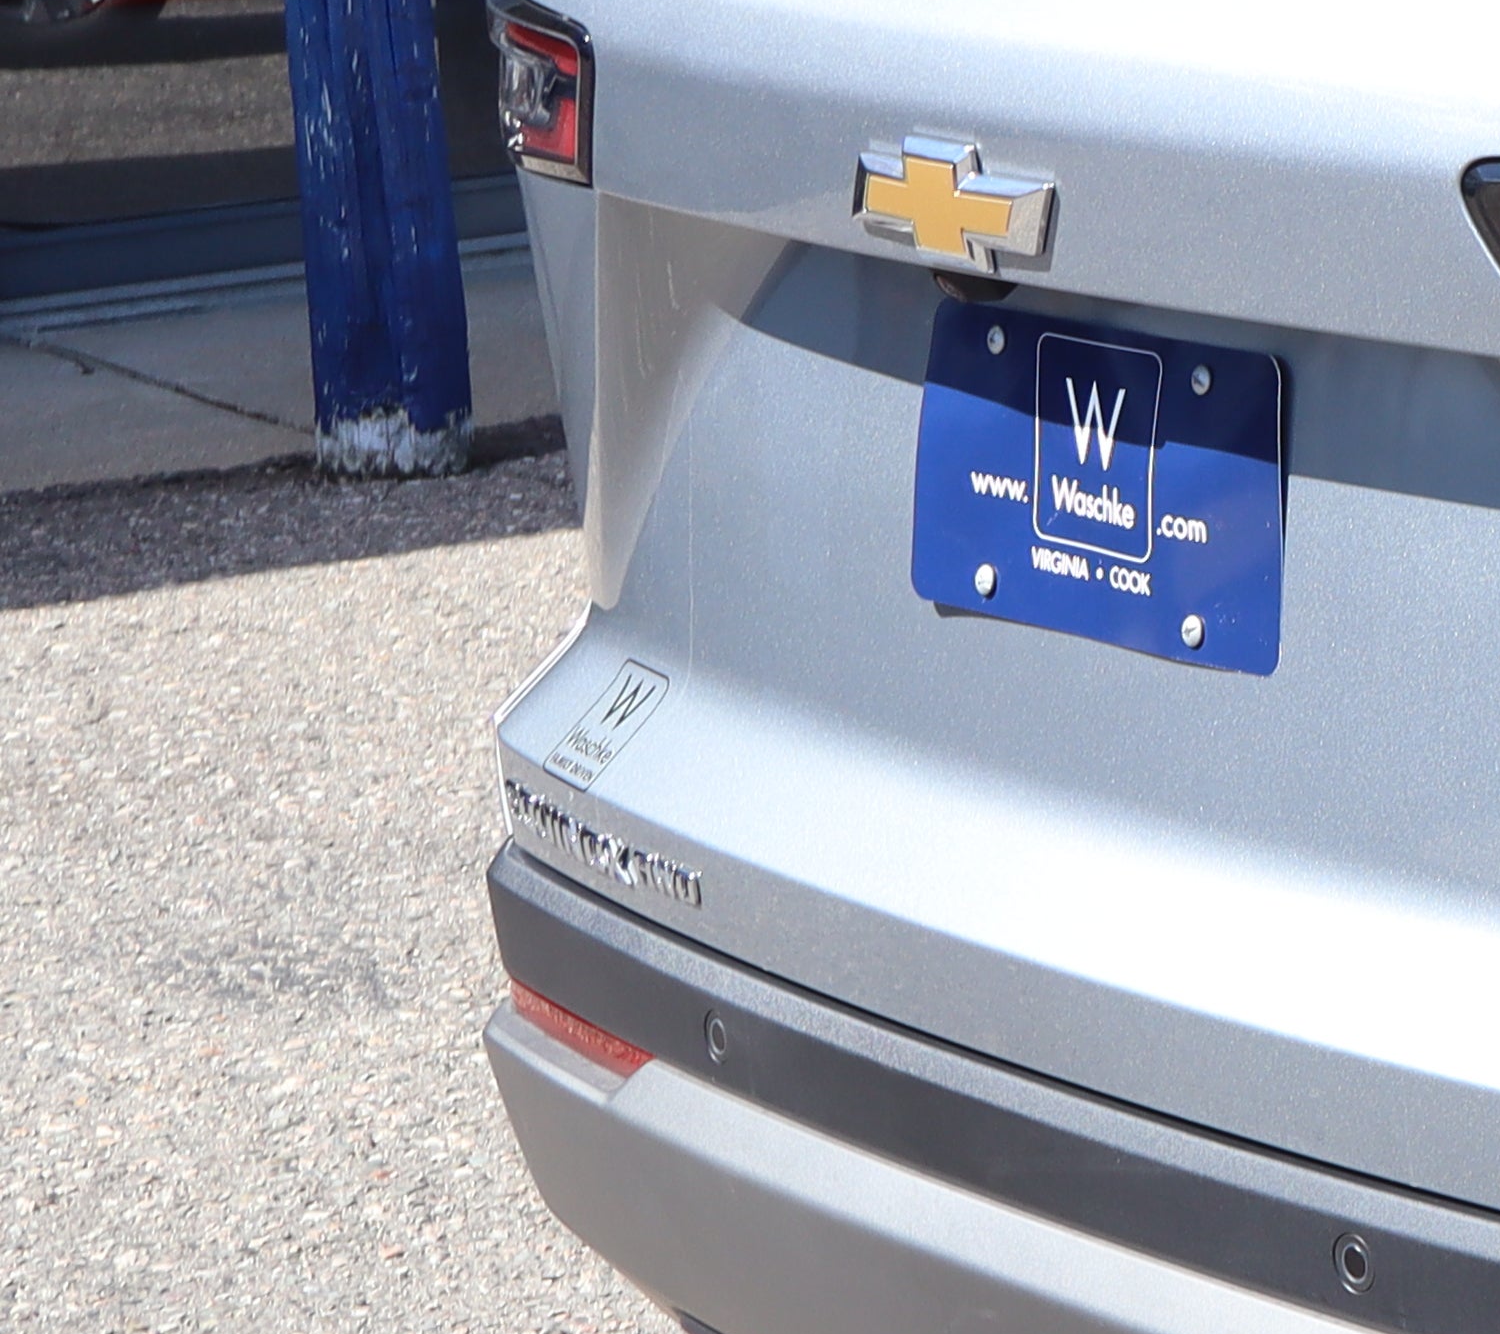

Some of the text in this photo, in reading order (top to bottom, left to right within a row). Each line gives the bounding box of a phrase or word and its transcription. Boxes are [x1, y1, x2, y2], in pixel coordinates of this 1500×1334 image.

[1066, 377, 1126, 471] W
[971, 471, 1208, 544] www. Waschke .com
[1031, 545, 1151, 597] VIRGINIA COOK
[600, 672, 657, 731] W
